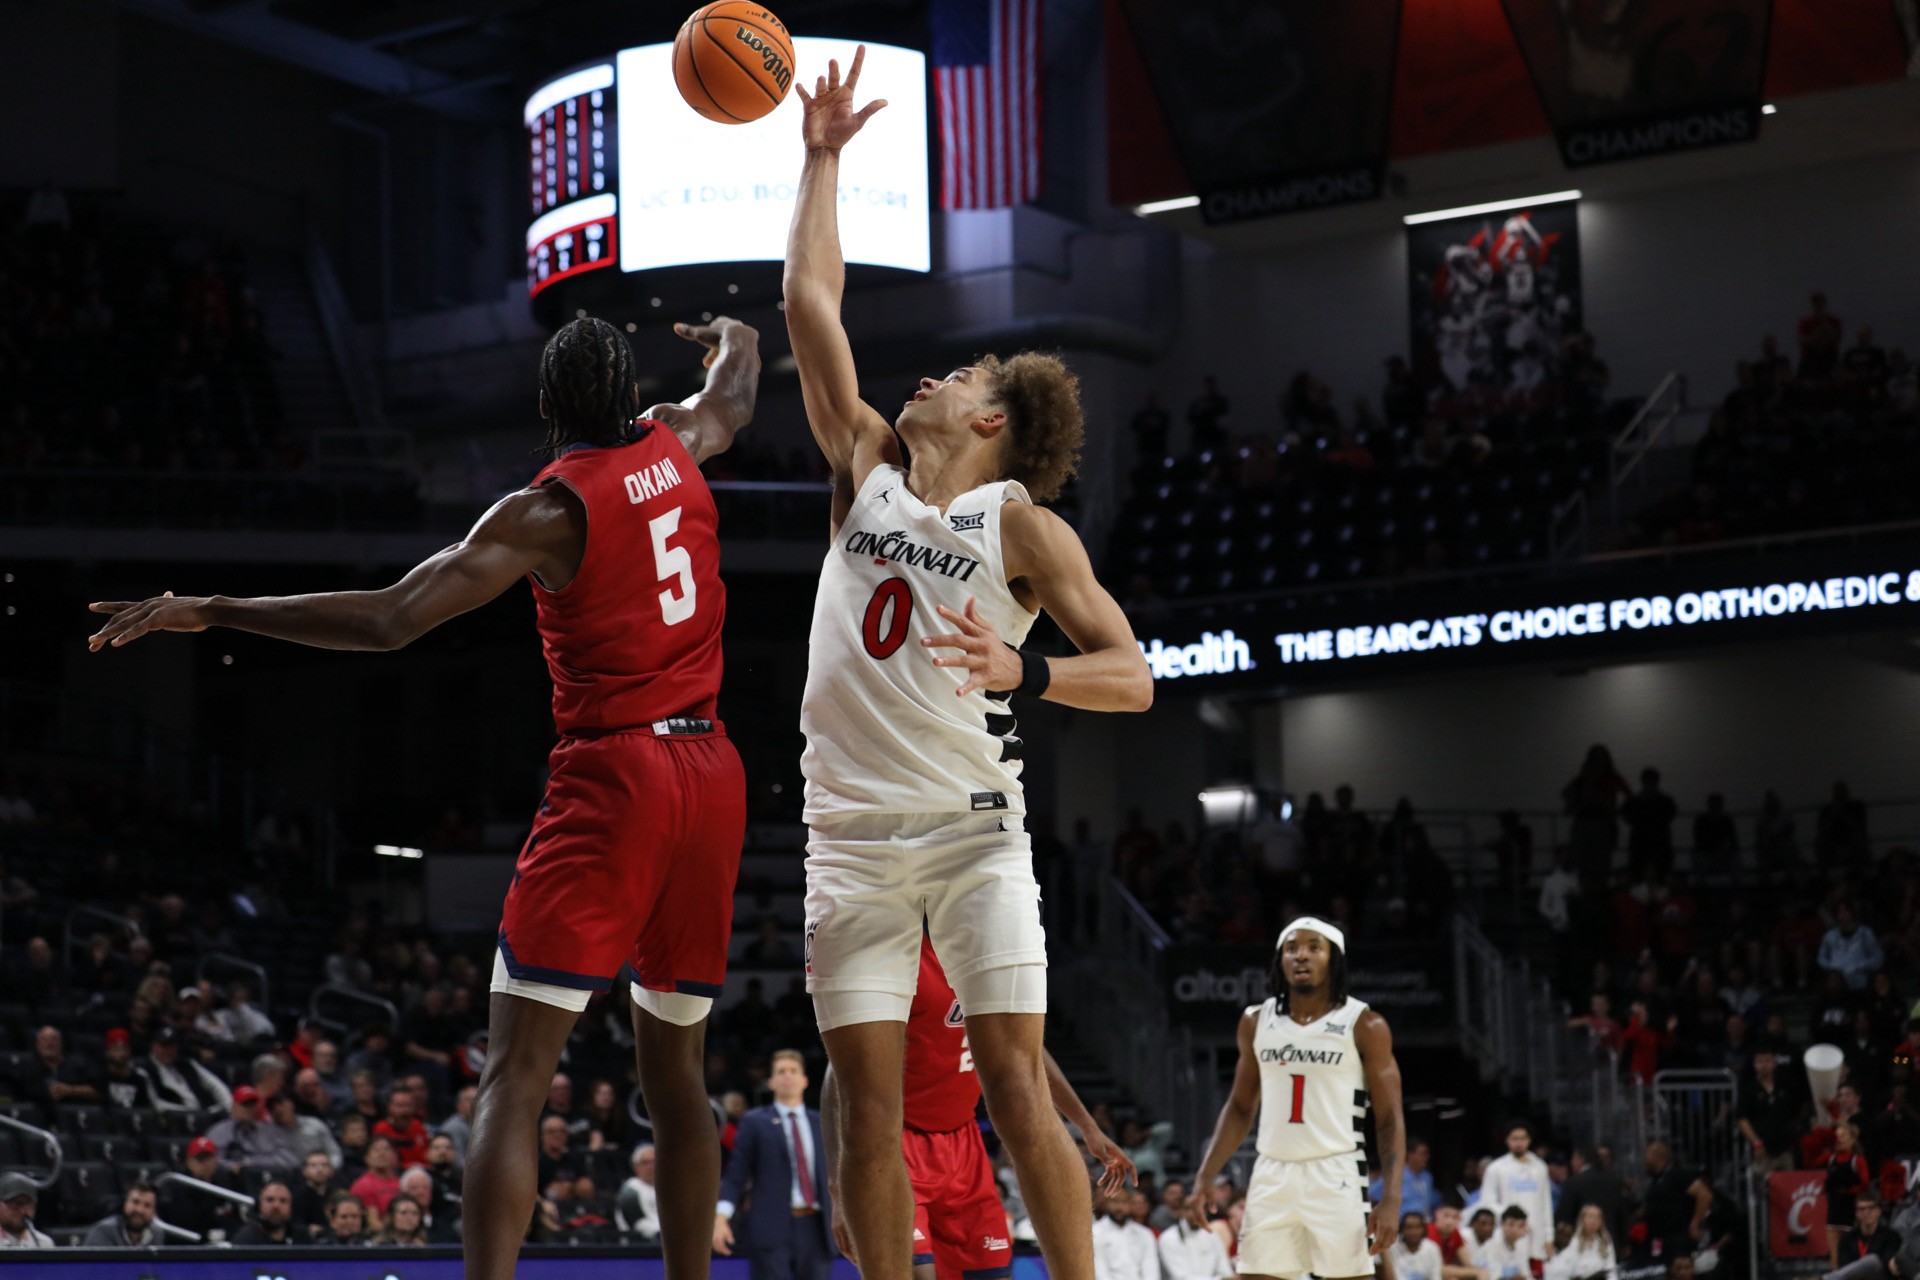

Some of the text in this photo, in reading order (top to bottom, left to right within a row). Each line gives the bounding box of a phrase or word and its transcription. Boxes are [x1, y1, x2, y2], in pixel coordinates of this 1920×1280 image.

[736, 26, 792, 94] Wilson
[1567, 108, 1750, 161] CHAMPIONS
[1206, 168, 1375, 219] CHAMPIONS
[623, 457, 683, 505] OKANI
[648, 505, 697, 627] 5
[845, 530, 980, 582] CINCINNATI
[861, 576, 914, 661] 0
[1274, 630, 1334, 664] THE
[1489, 601, 1607, 643] CHOICE
[1609, 595, 1674, 631] FOR
[1674, 571, 1901, 624] ORTHOPAEDIC
[1260, 1046, 1344, 1065] CINCINNATI
[1288, 1073, 1306, 1124] 1
